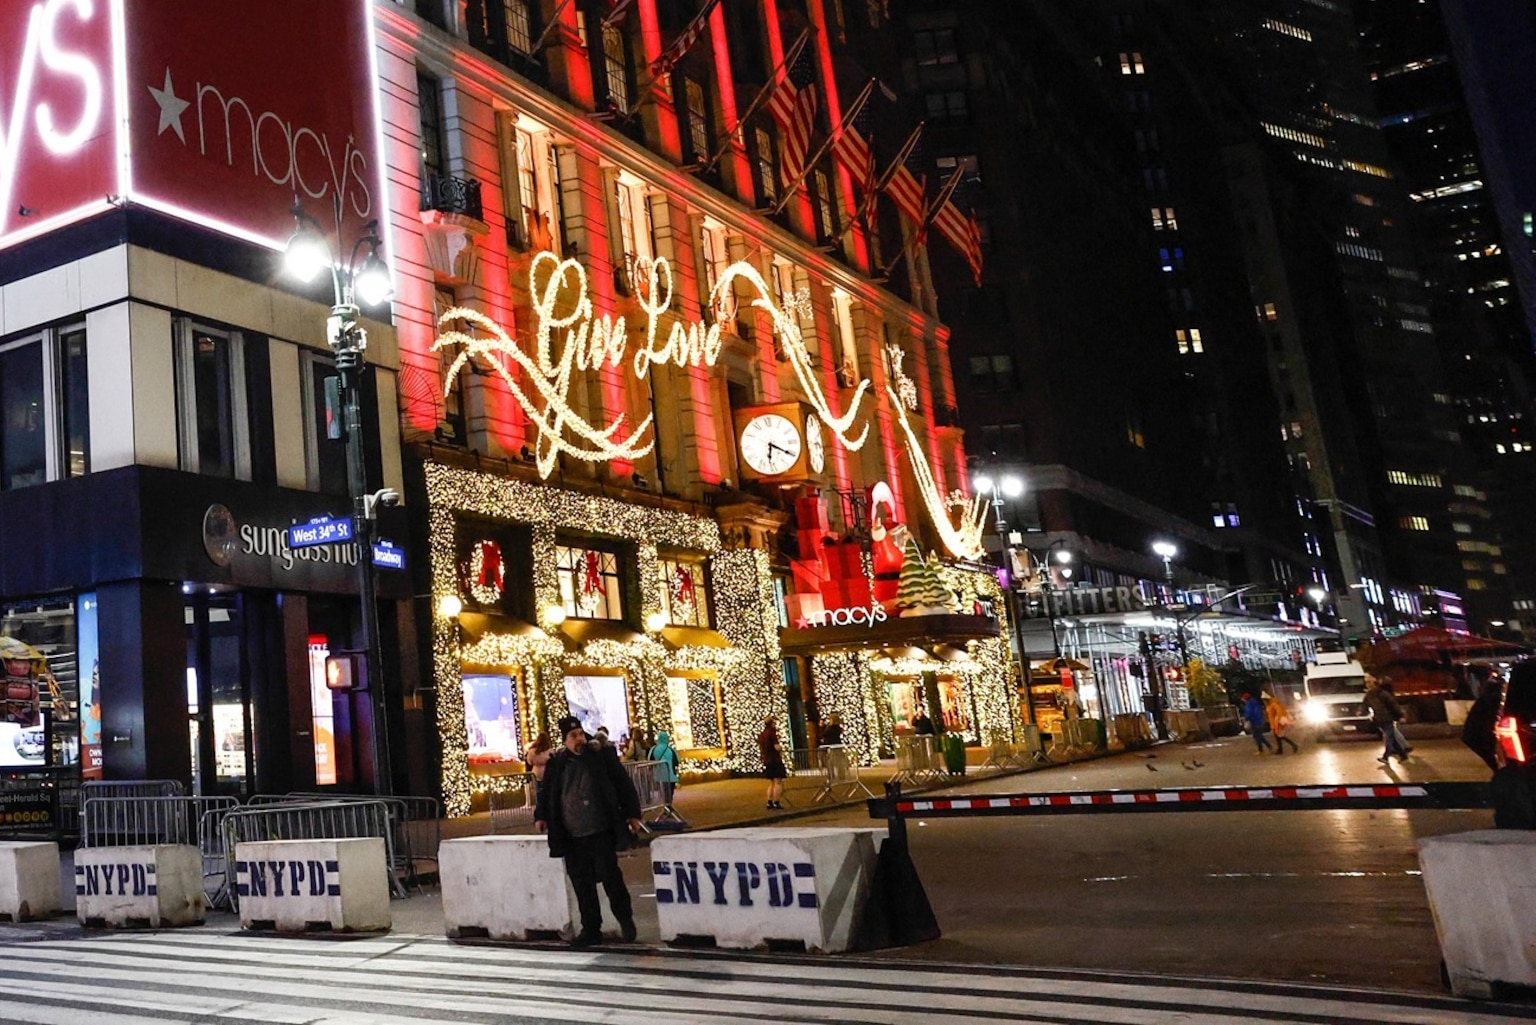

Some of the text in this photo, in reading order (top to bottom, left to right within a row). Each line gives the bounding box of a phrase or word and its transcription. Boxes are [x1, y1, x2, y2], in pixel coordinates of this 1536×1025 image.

[634, 255, 723, 379] Love
[293, 523, 349, 543] West 34th St
[374, 547, 401, 568] Broadway
[811, 603, 888, 628] macy's
[85, 863, 146, 896] NYPD
[248, 860, 325, 897] NYPD
[673, 861, 794, 907] NYPD
